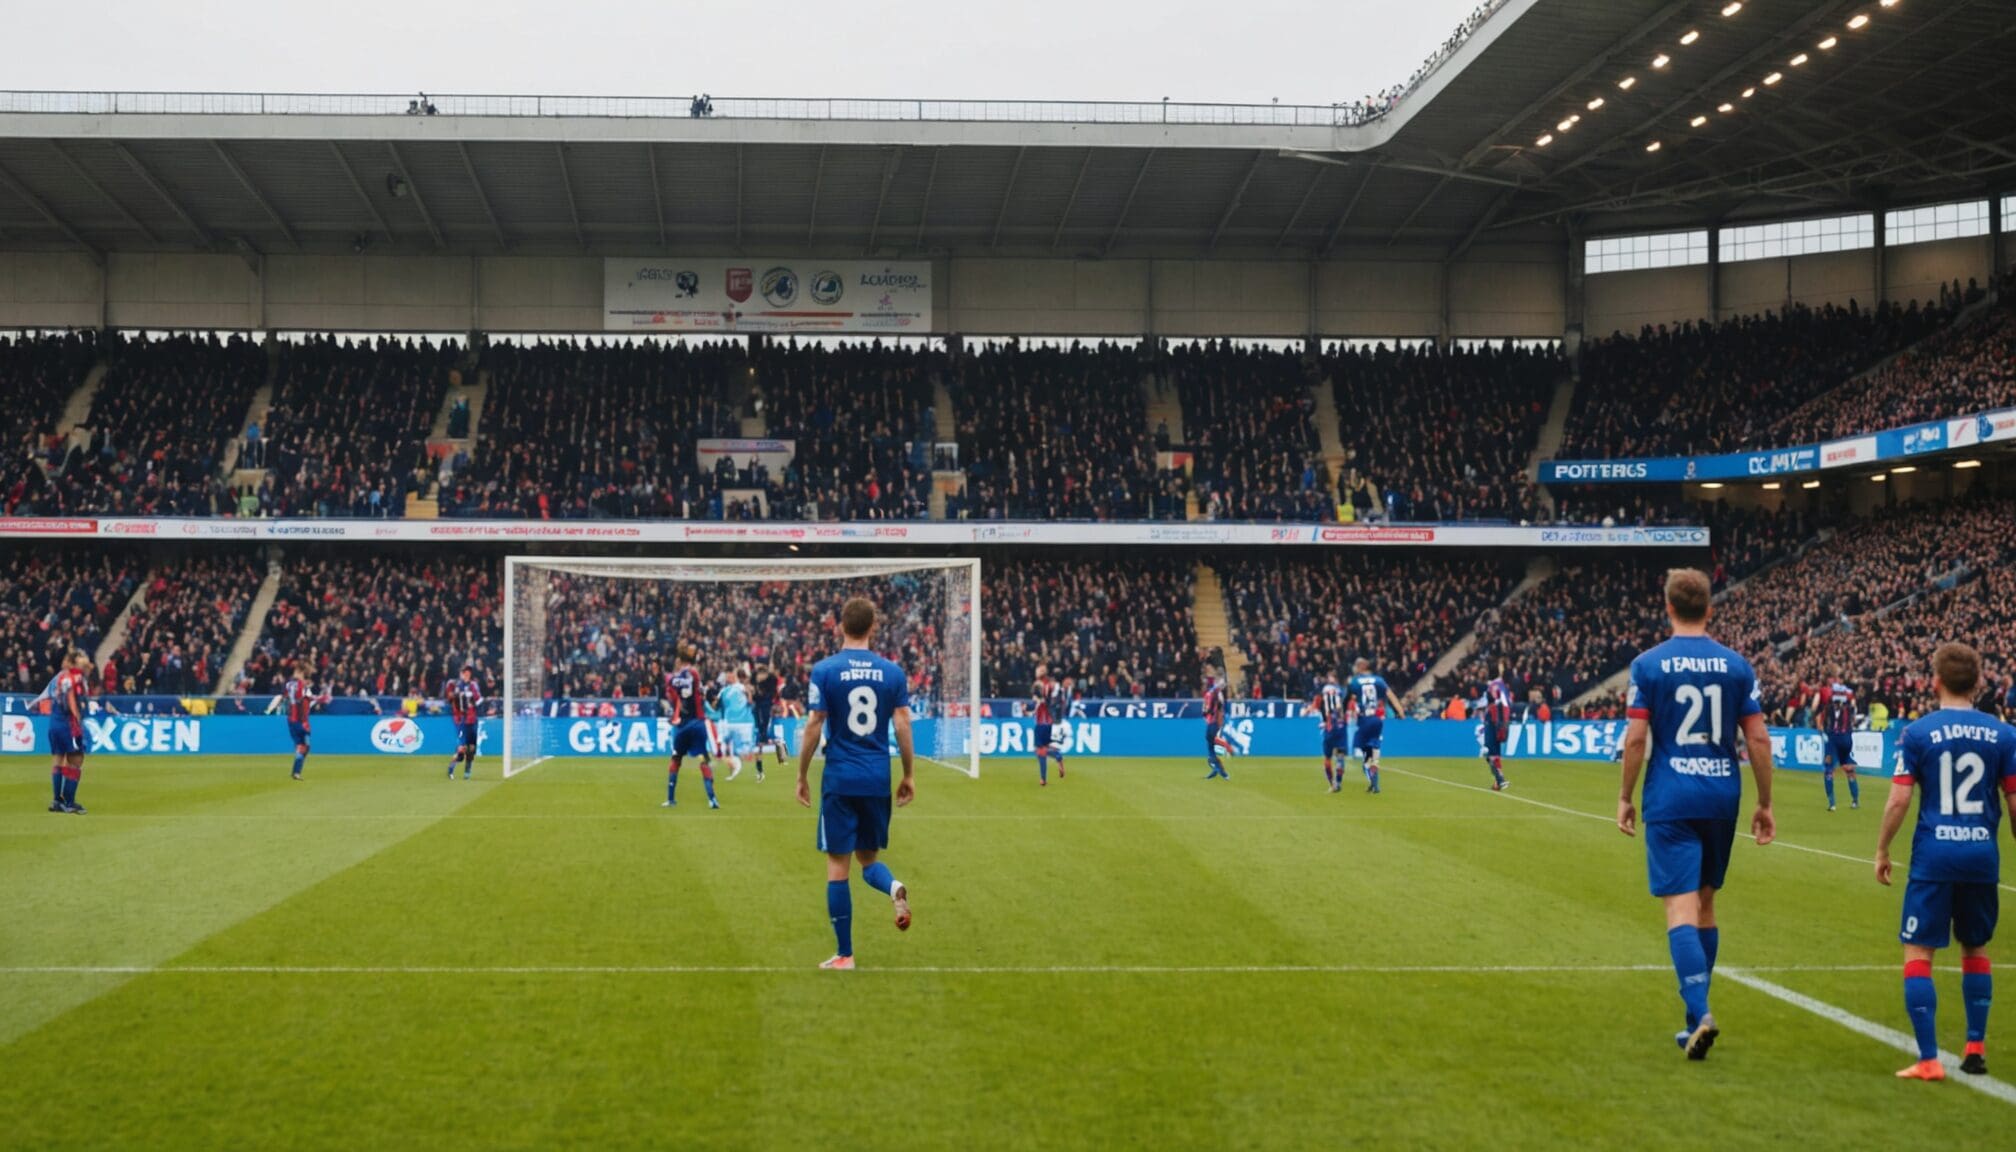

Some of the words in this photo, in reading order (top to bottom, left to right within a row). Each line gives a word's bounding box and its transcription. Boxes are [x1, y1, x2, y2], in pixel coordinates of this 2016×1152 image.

[847, 685, 877, 736] 8
[1675, 684, 1721, 746] 21
[1939, 751, 1985, 815] 12
